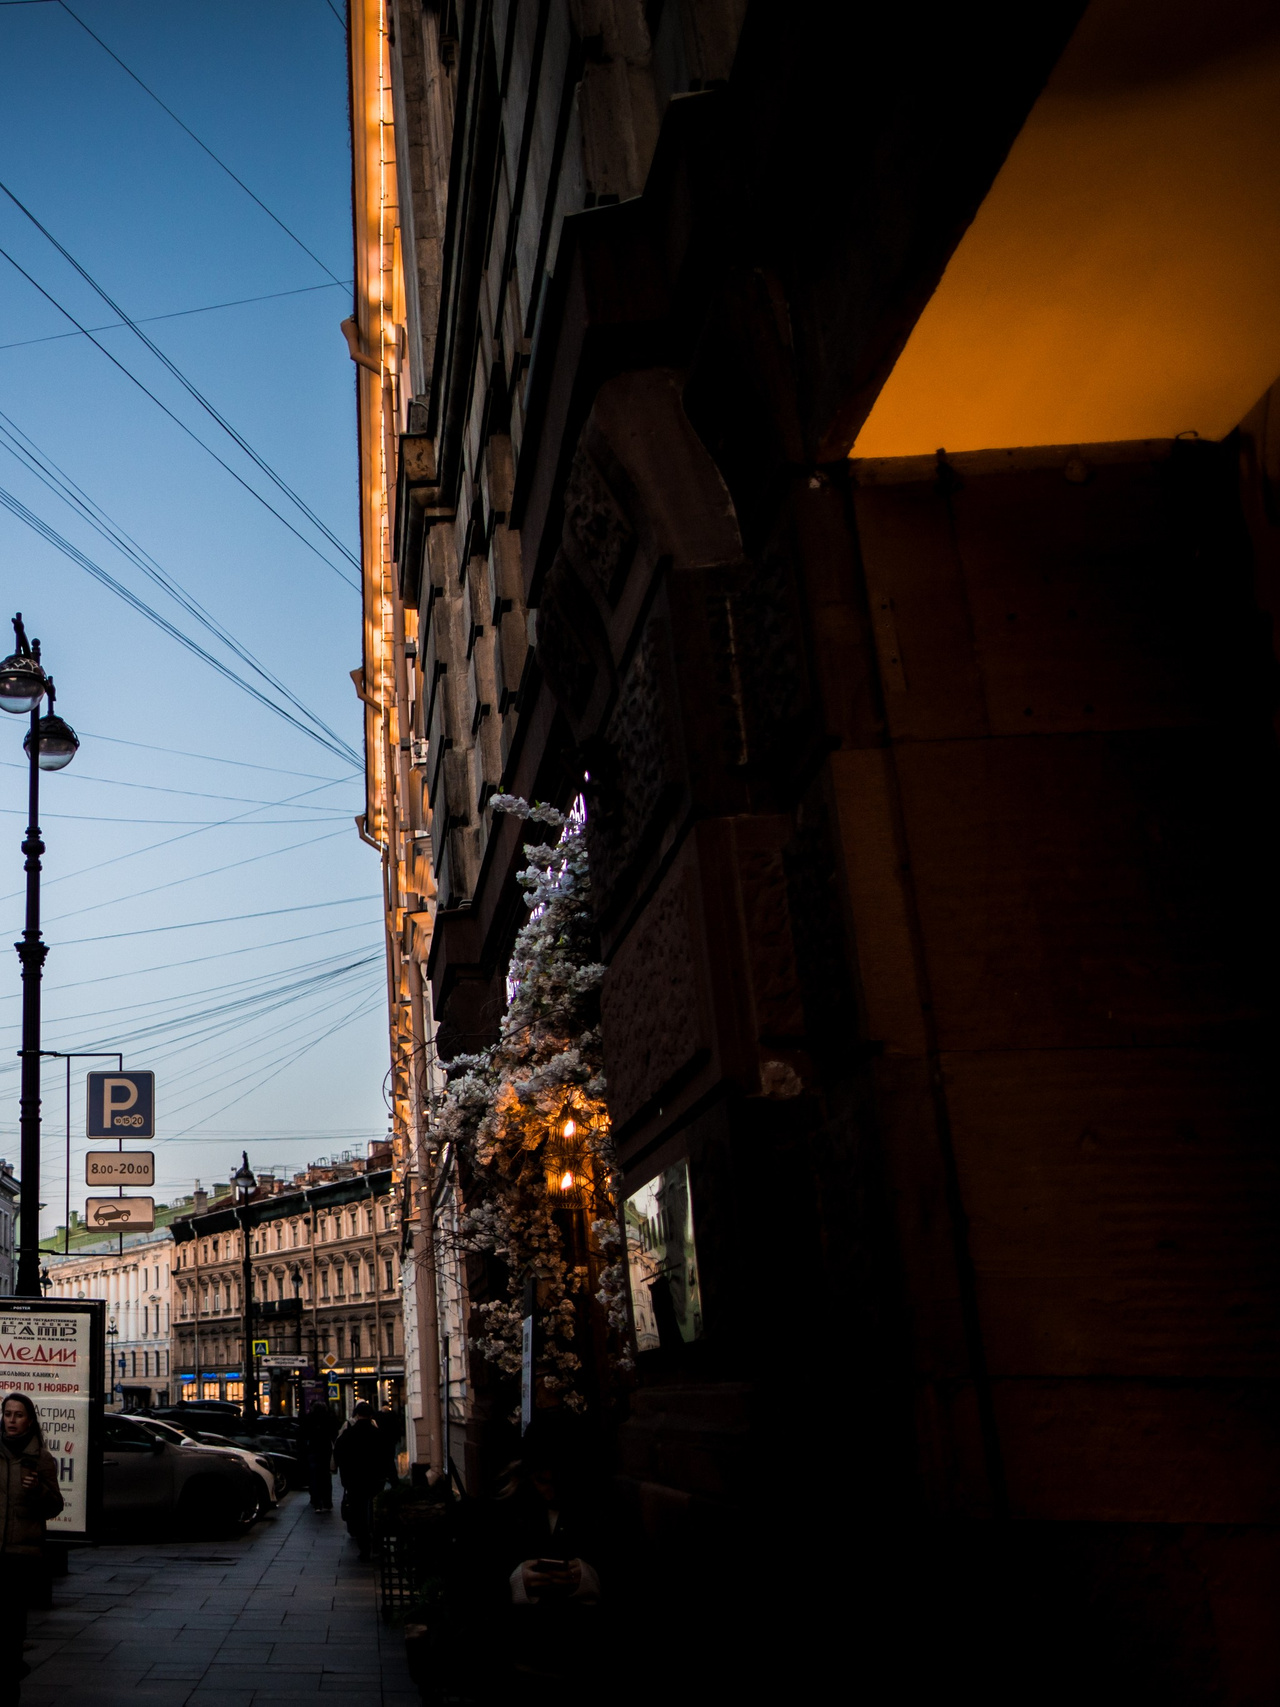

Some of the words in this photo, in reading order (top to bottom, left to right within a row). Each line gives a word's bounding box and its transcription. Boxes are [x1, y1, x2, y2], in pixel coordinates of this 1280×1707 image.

[103, 1078, 138, 1128] P
[122, 1117, 130, 1125] 15
[132, 1116, 143, 1125] 20
[91, 1163, 149, 1174] 8.00-20.00
[24, 1381, 35, 1391] ПО
[37, 1382, 42, 1391] 1
[44, 1383, 79, 1393] НОЯБРЯ
[34, 1404, 75, 1420] Астрид
